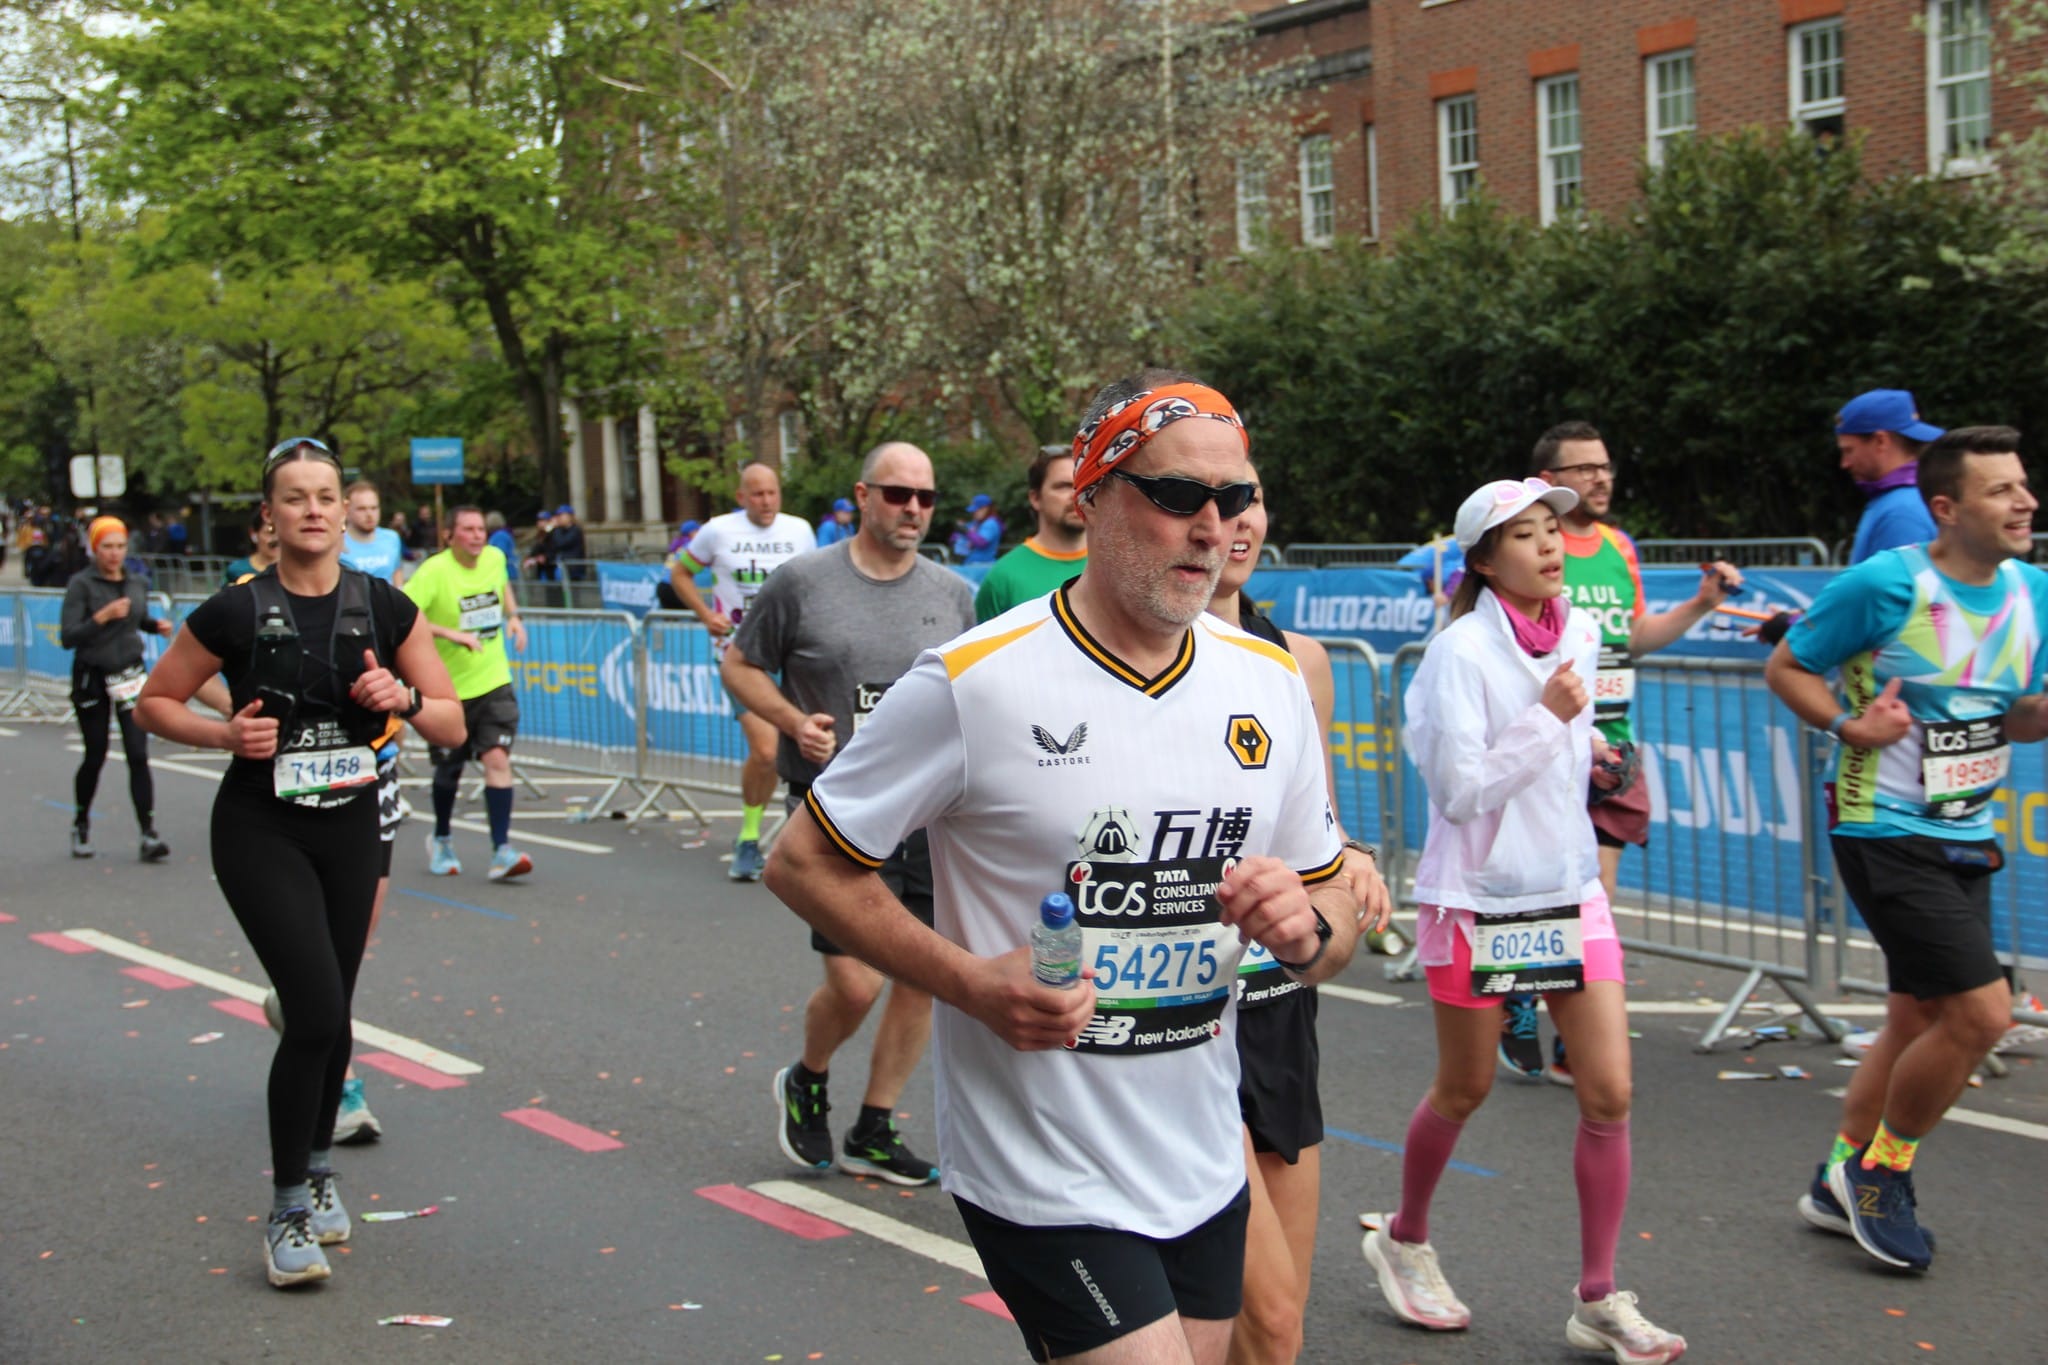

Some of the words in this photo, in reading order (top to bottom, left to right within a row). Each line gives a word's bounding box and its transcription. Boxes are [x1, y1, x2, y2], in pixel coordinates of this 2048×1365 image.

[731, 542, 795, 554] JAMES
[1294, 586, 1431, 632] Lucozade
[857, 684, 881, 709] tc
[291, 756, 361, 785] 71458
[1038, 757, 1091, 767] CASTORE
[1153, 869, 1190, 883] TATA
[1152, 882, 1222, 900] CONSULTAN
[1152, 899, 1205, 916] SERVICES
[1491, 929, 1564, 961] 60246
[1092, 939, 1217, 991] 54275
[1246, 990, 1270, 1002] new
[1134, 1032, 1164, 1046] new
[1071, 1258, 1120, 1327] SALOMON
